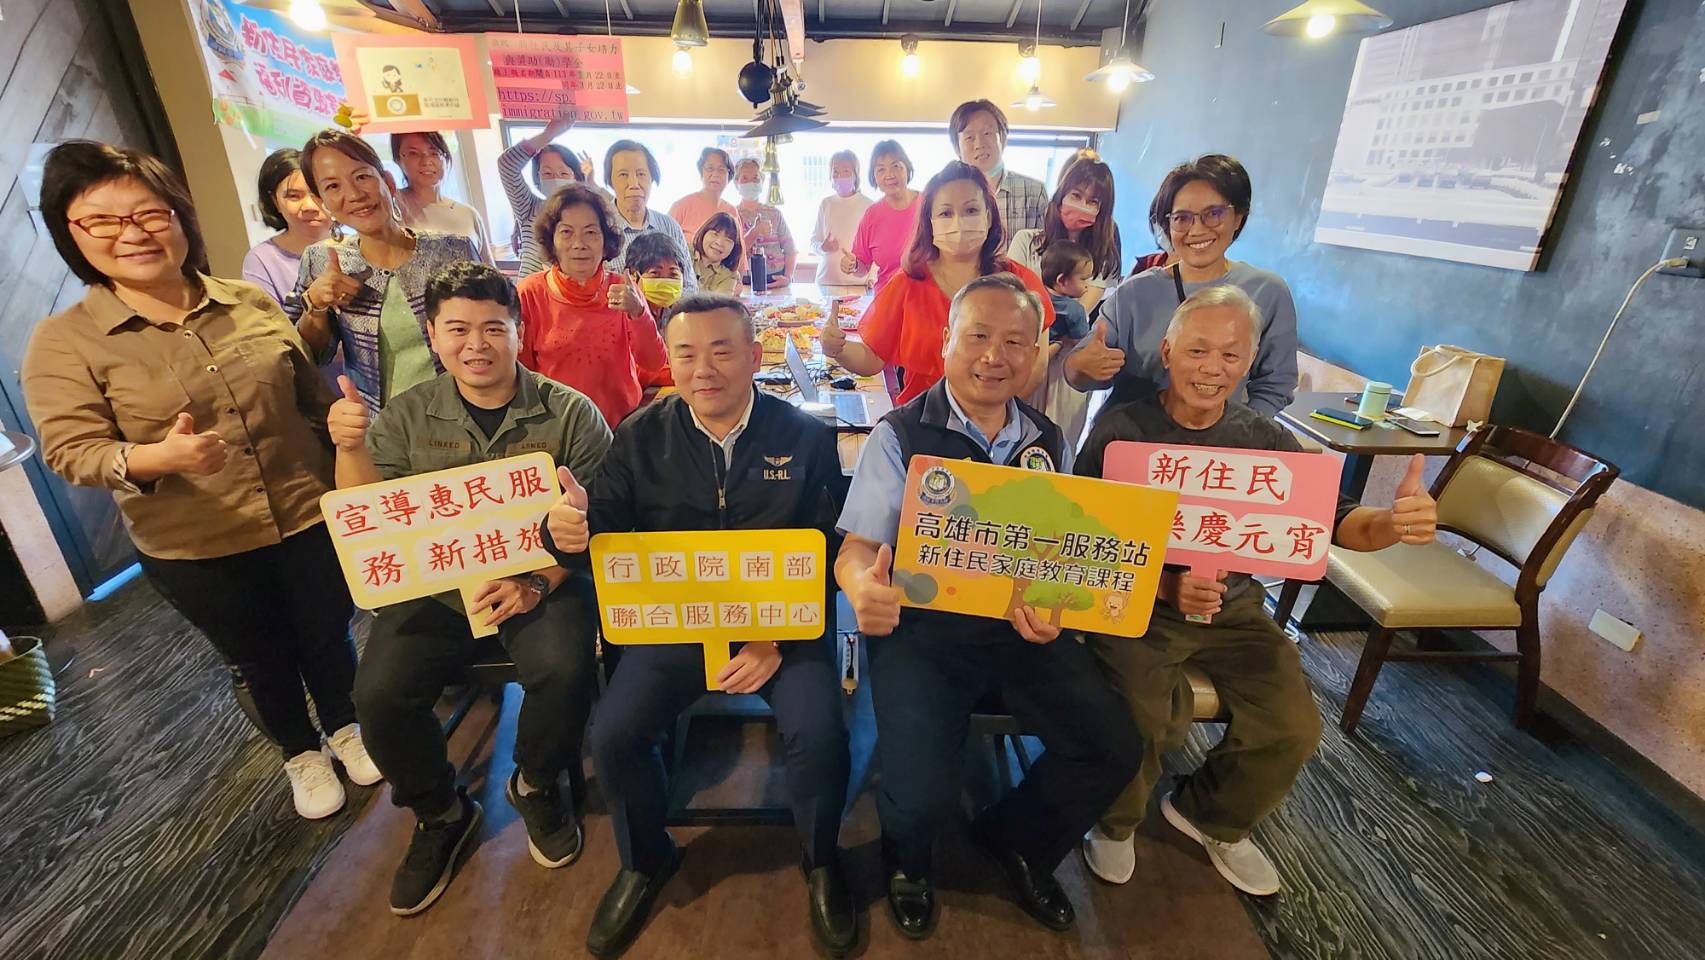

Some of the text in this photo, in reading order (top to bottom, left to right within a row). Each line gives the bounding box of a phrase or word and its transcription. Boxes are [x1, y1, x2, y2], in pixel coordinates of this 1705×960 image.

[335, 465, 551, 537] 宣導惠民服
[1151, 453, 1286, 501] 新住民
[913, 512, 1151, 567] 高雄市第一服務站
[607, 555, 812, 579] 行政院南部
[918, 544, 1135, 592] 新住民家庭教育課程
[611, 603, 817, 629] 聯合服務中心
